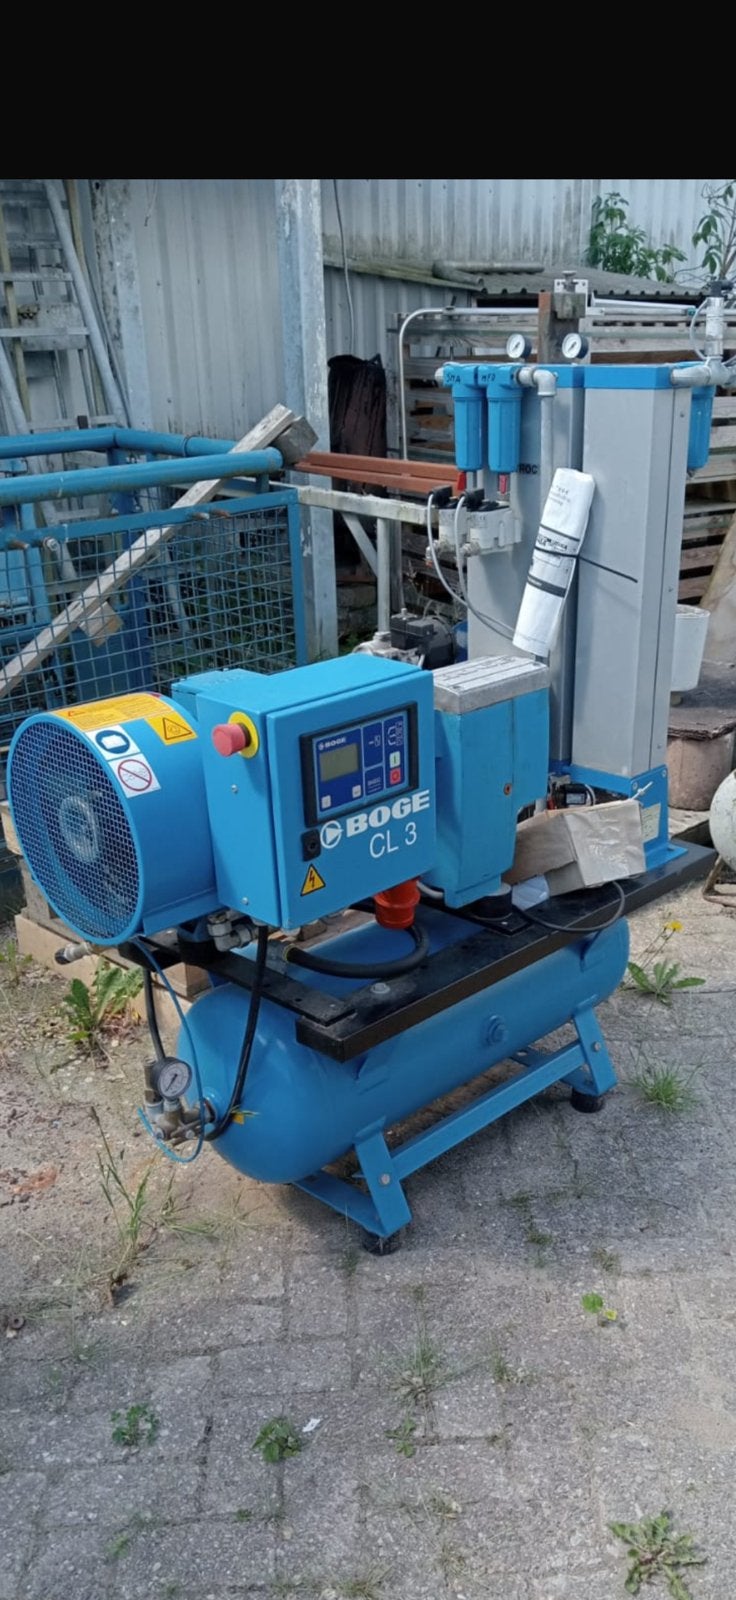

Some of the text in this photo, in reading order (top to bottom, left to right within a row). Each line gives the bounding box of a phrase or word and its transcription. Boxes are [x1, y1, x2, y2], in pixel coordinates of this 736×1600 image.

[517, 463, 538, 474] ROC
[324, 737, 347, 747] BOGE
[346, 789, 430, 837] BOGE
[369, 822, 418, 859] CL 3
